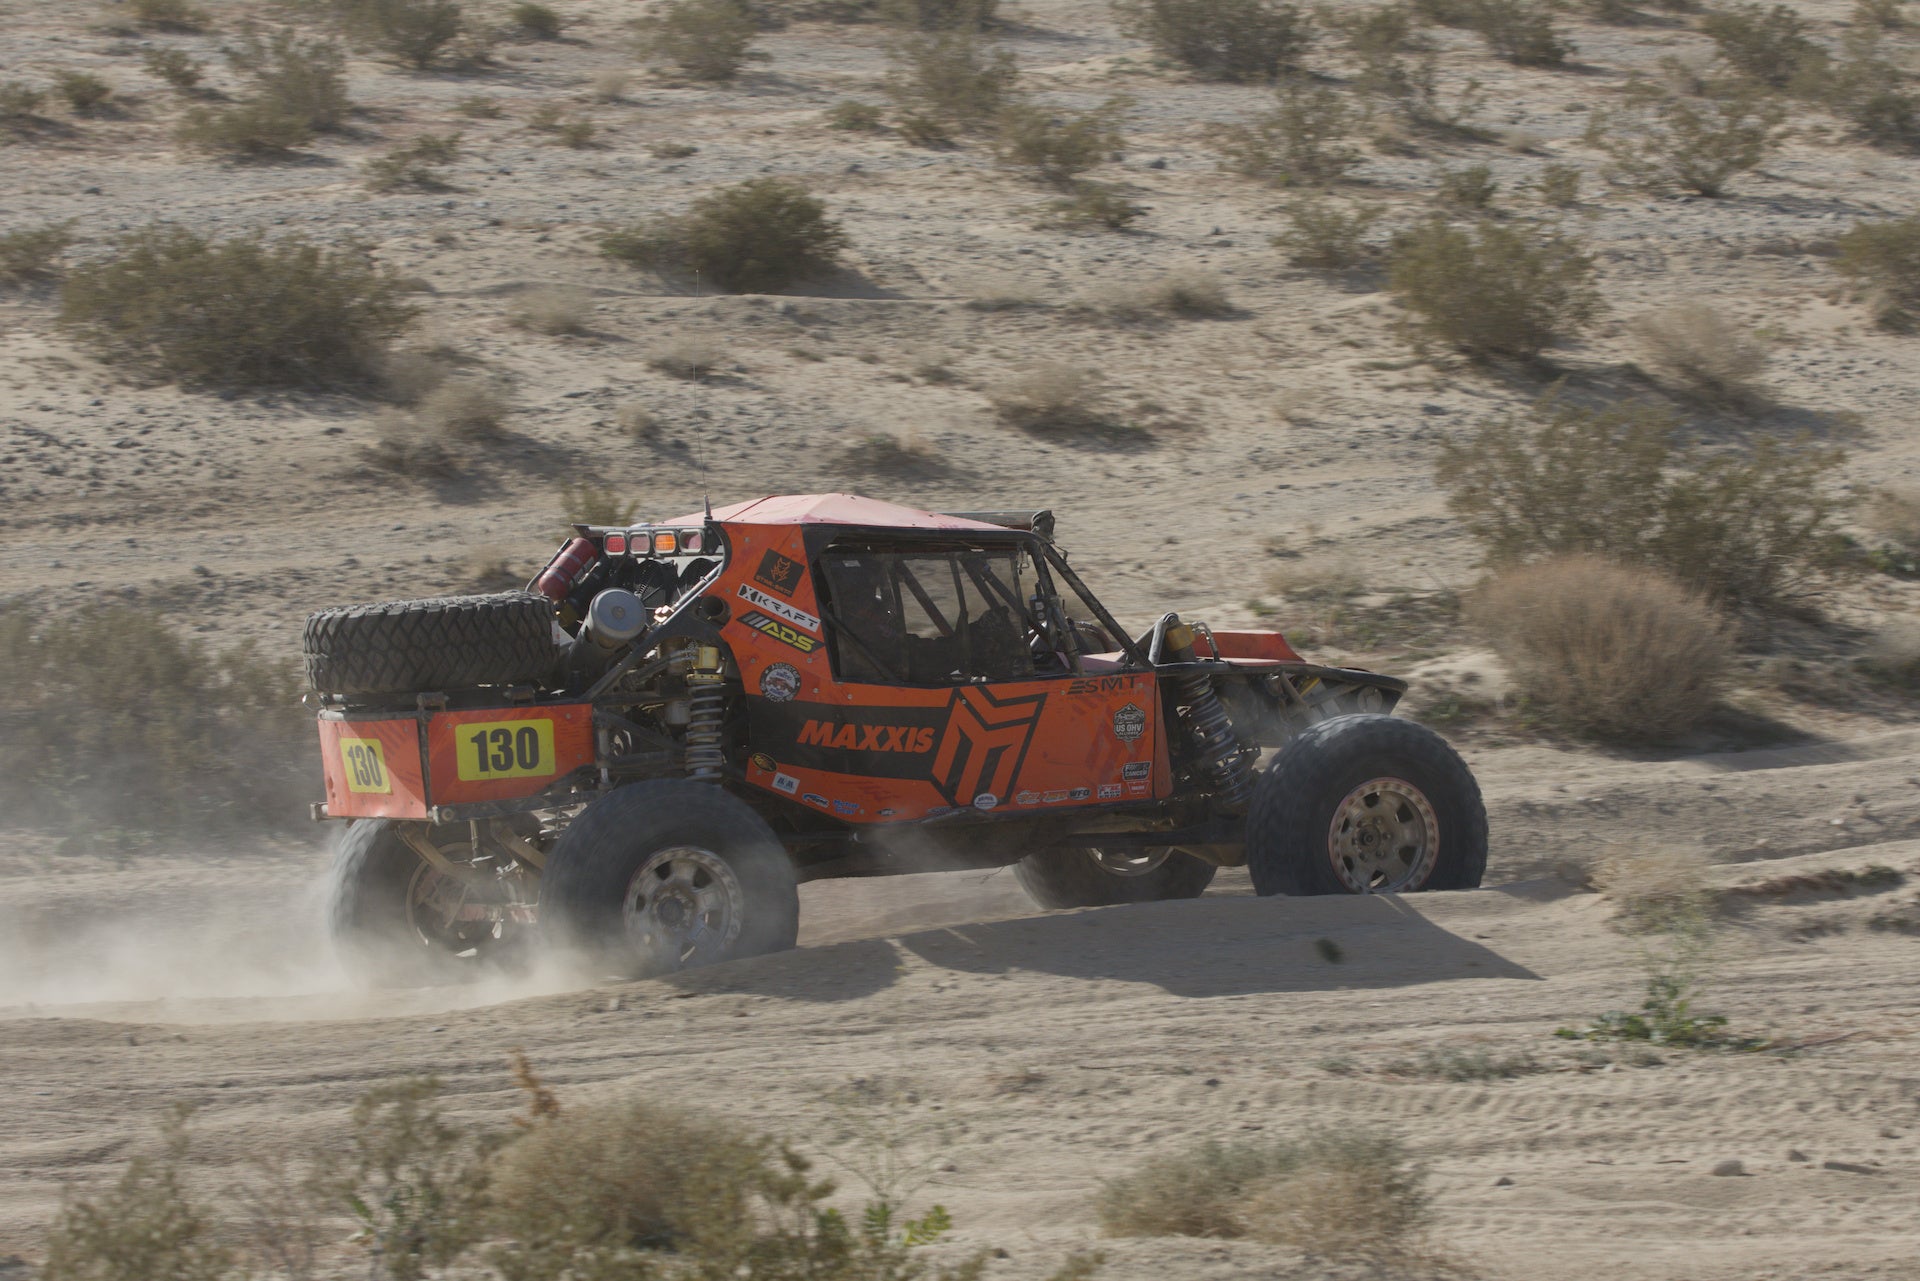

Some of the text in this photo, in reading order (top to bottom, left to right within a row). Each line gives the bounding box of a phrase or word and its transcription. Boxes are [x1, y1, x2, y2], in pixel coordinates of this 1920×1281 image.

[761, 622, 815, 652] ADS
[796, 719, 935, 753] MAXXIS
[1116, 723, 1142, 732] US OHV
[470, 726, 540, 772] 130
[347, 744, 383, 787] 130
[1069, 789, 1090, 797] WFO
